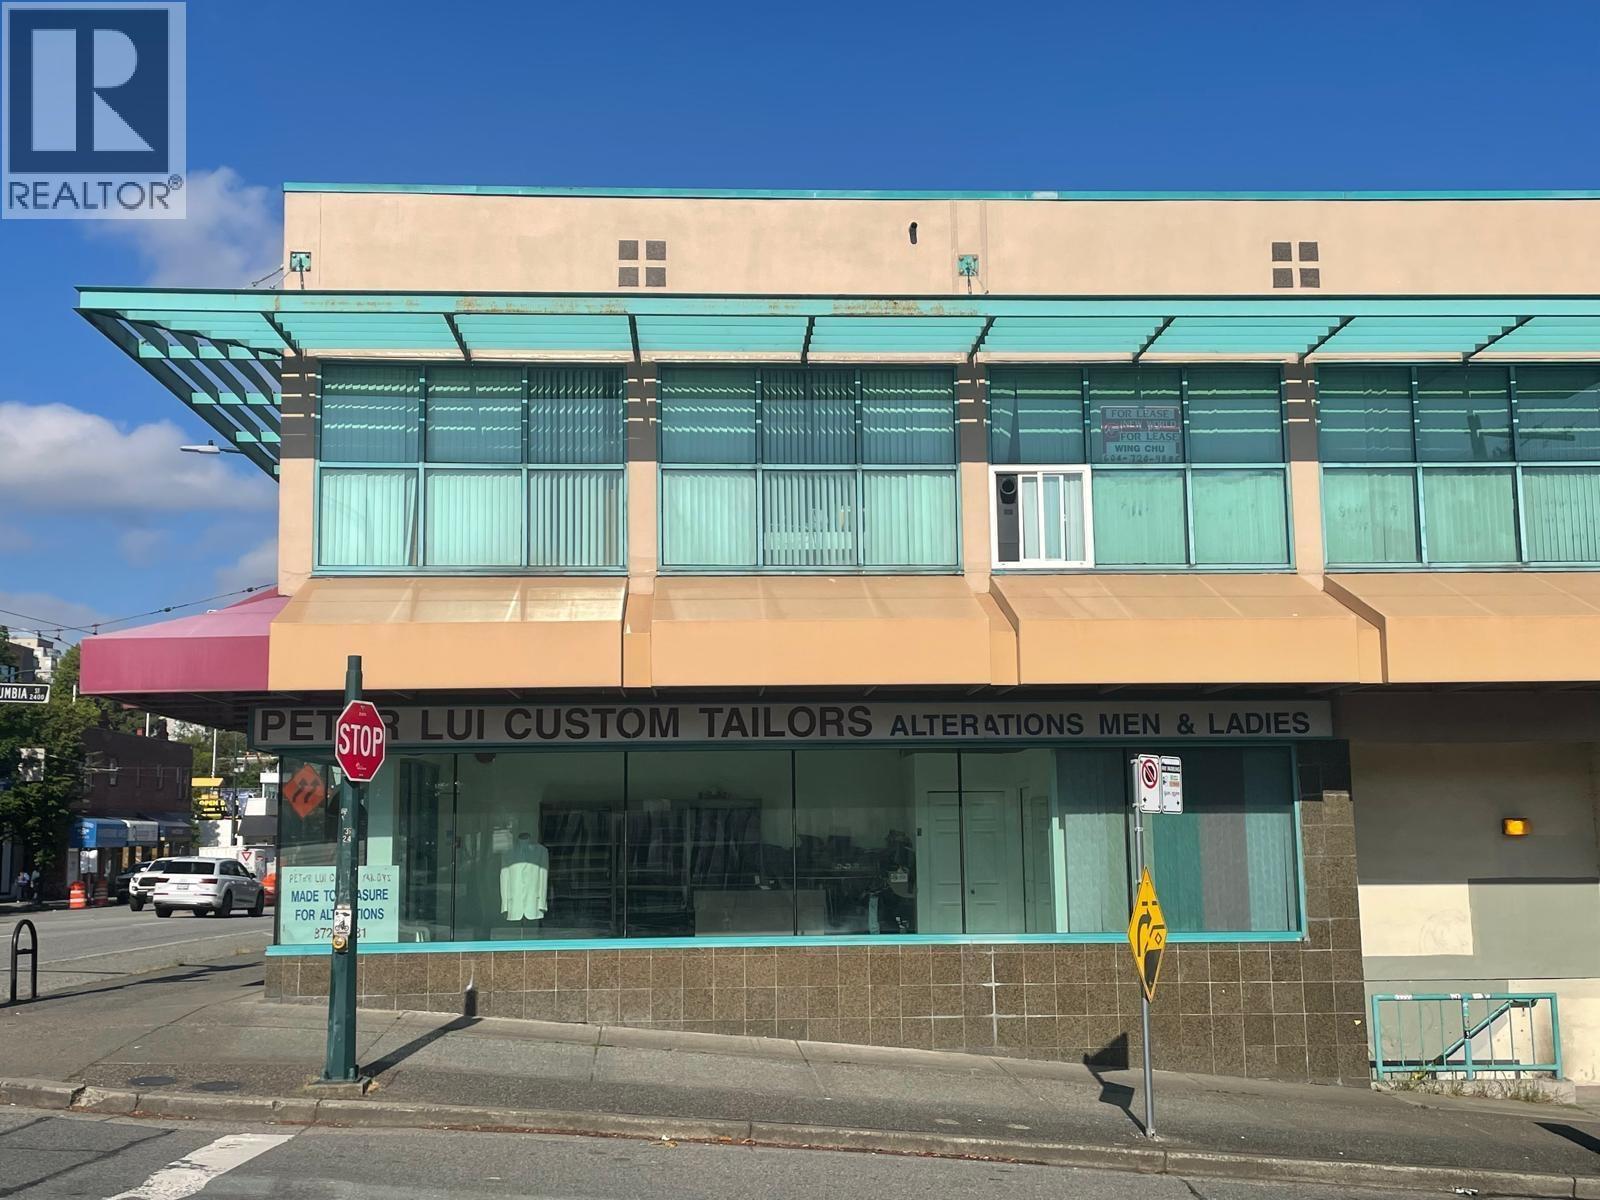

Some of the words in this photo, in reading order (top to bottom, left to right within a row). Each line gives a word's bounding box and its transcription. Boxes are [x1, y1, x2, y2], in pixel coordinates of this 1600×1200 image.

[1111, 409, 1132, 418] FOR
[1136, 409, 1170, 418] LEASE
[1120, 432, 1141, 441] FOR
[1146, 432, 1178, 441] LEASE
[1114, 444, 1140, 453] WING
[1144, 444, 1166, 453] CHU
[260, 709, 401, 742] PETR
[420, 709, 485, 740] LUI
[504, 706, 680, 740] CUSTOM
[698, 705, 873, 738] TAILORS
[889, 711, 1085, 737] ALTERATIONS
[1100, 712, 1161, 736] MEN
[1176, 712, 1196, 736] &
[1208, 711, 1310, 736] LADIES
[338, 722, 384, 758] STOP
[291, 890, 319, 902] MADE
[295, 908, 315, 920] FOR
